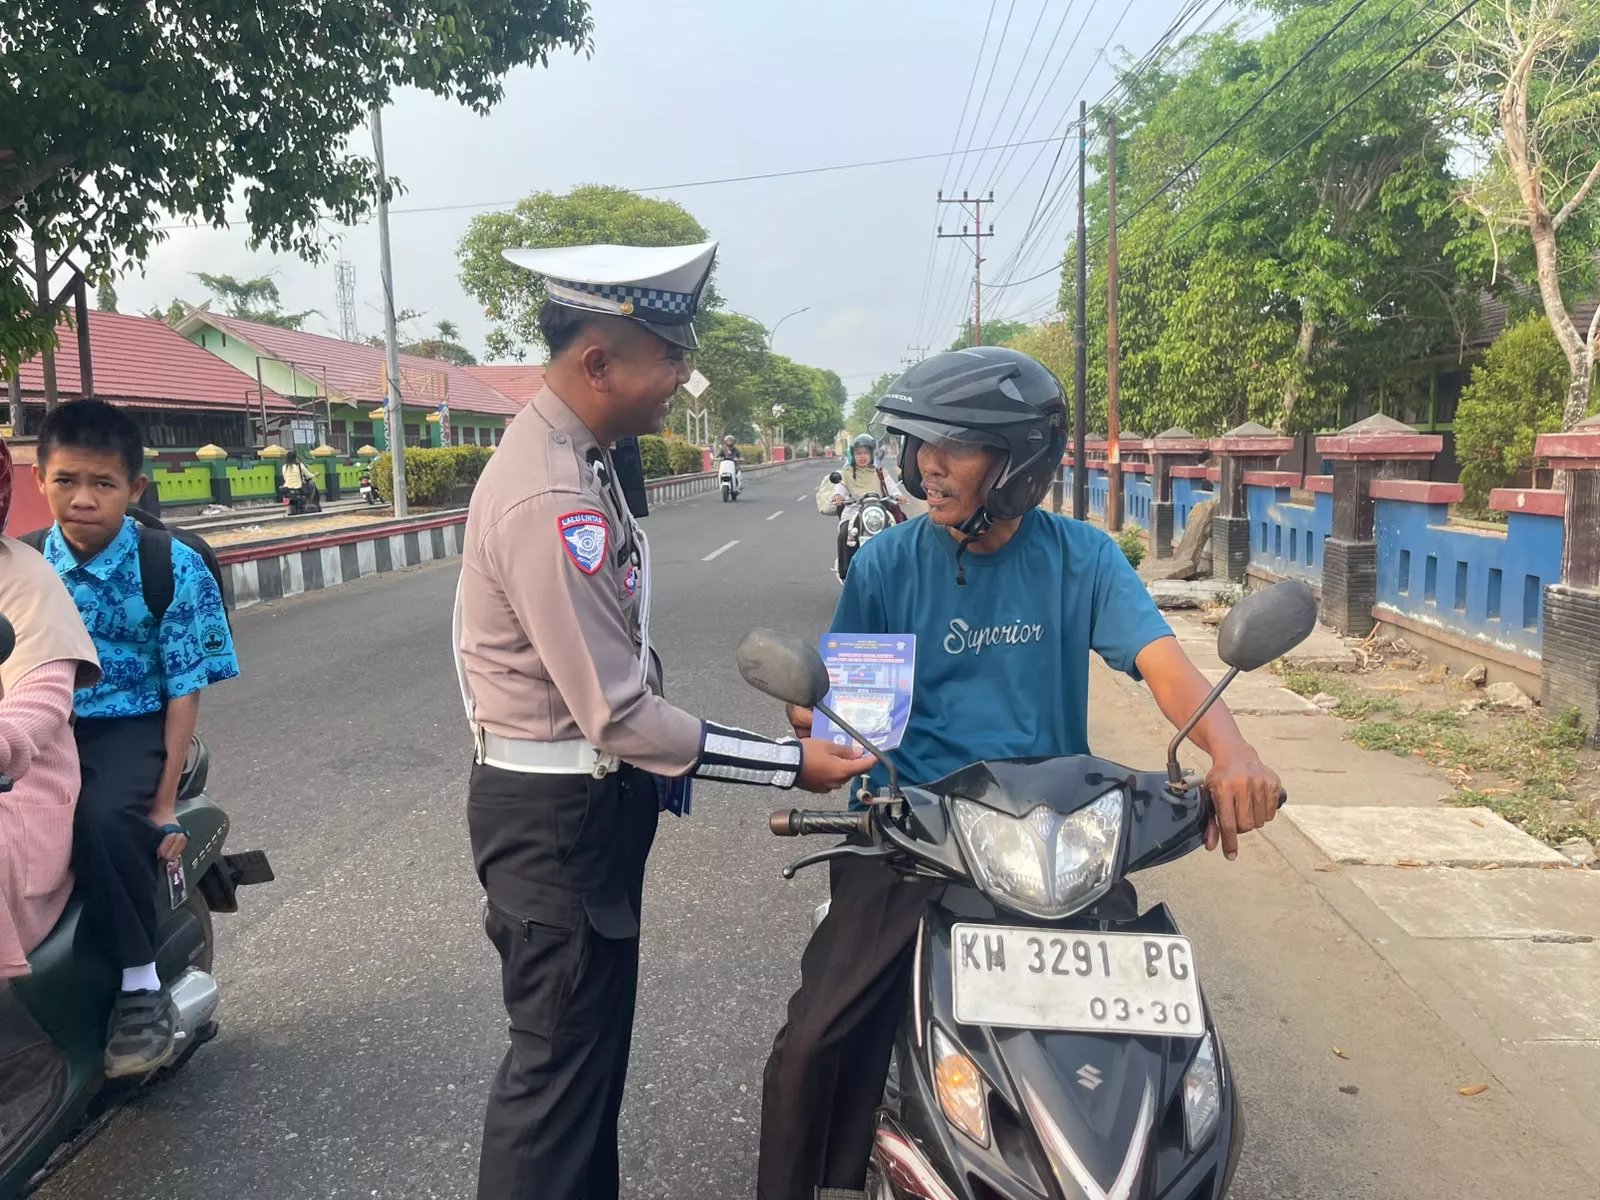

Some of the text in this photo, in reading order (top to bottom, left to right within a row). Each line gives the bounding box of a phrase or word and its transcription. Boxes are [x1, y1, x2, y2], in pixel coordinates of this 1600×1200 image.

[943, 617, 1045, 655] Superior
[960, 933, 1006, 972] KH
[1027, 937, 1111, 978] 3291
